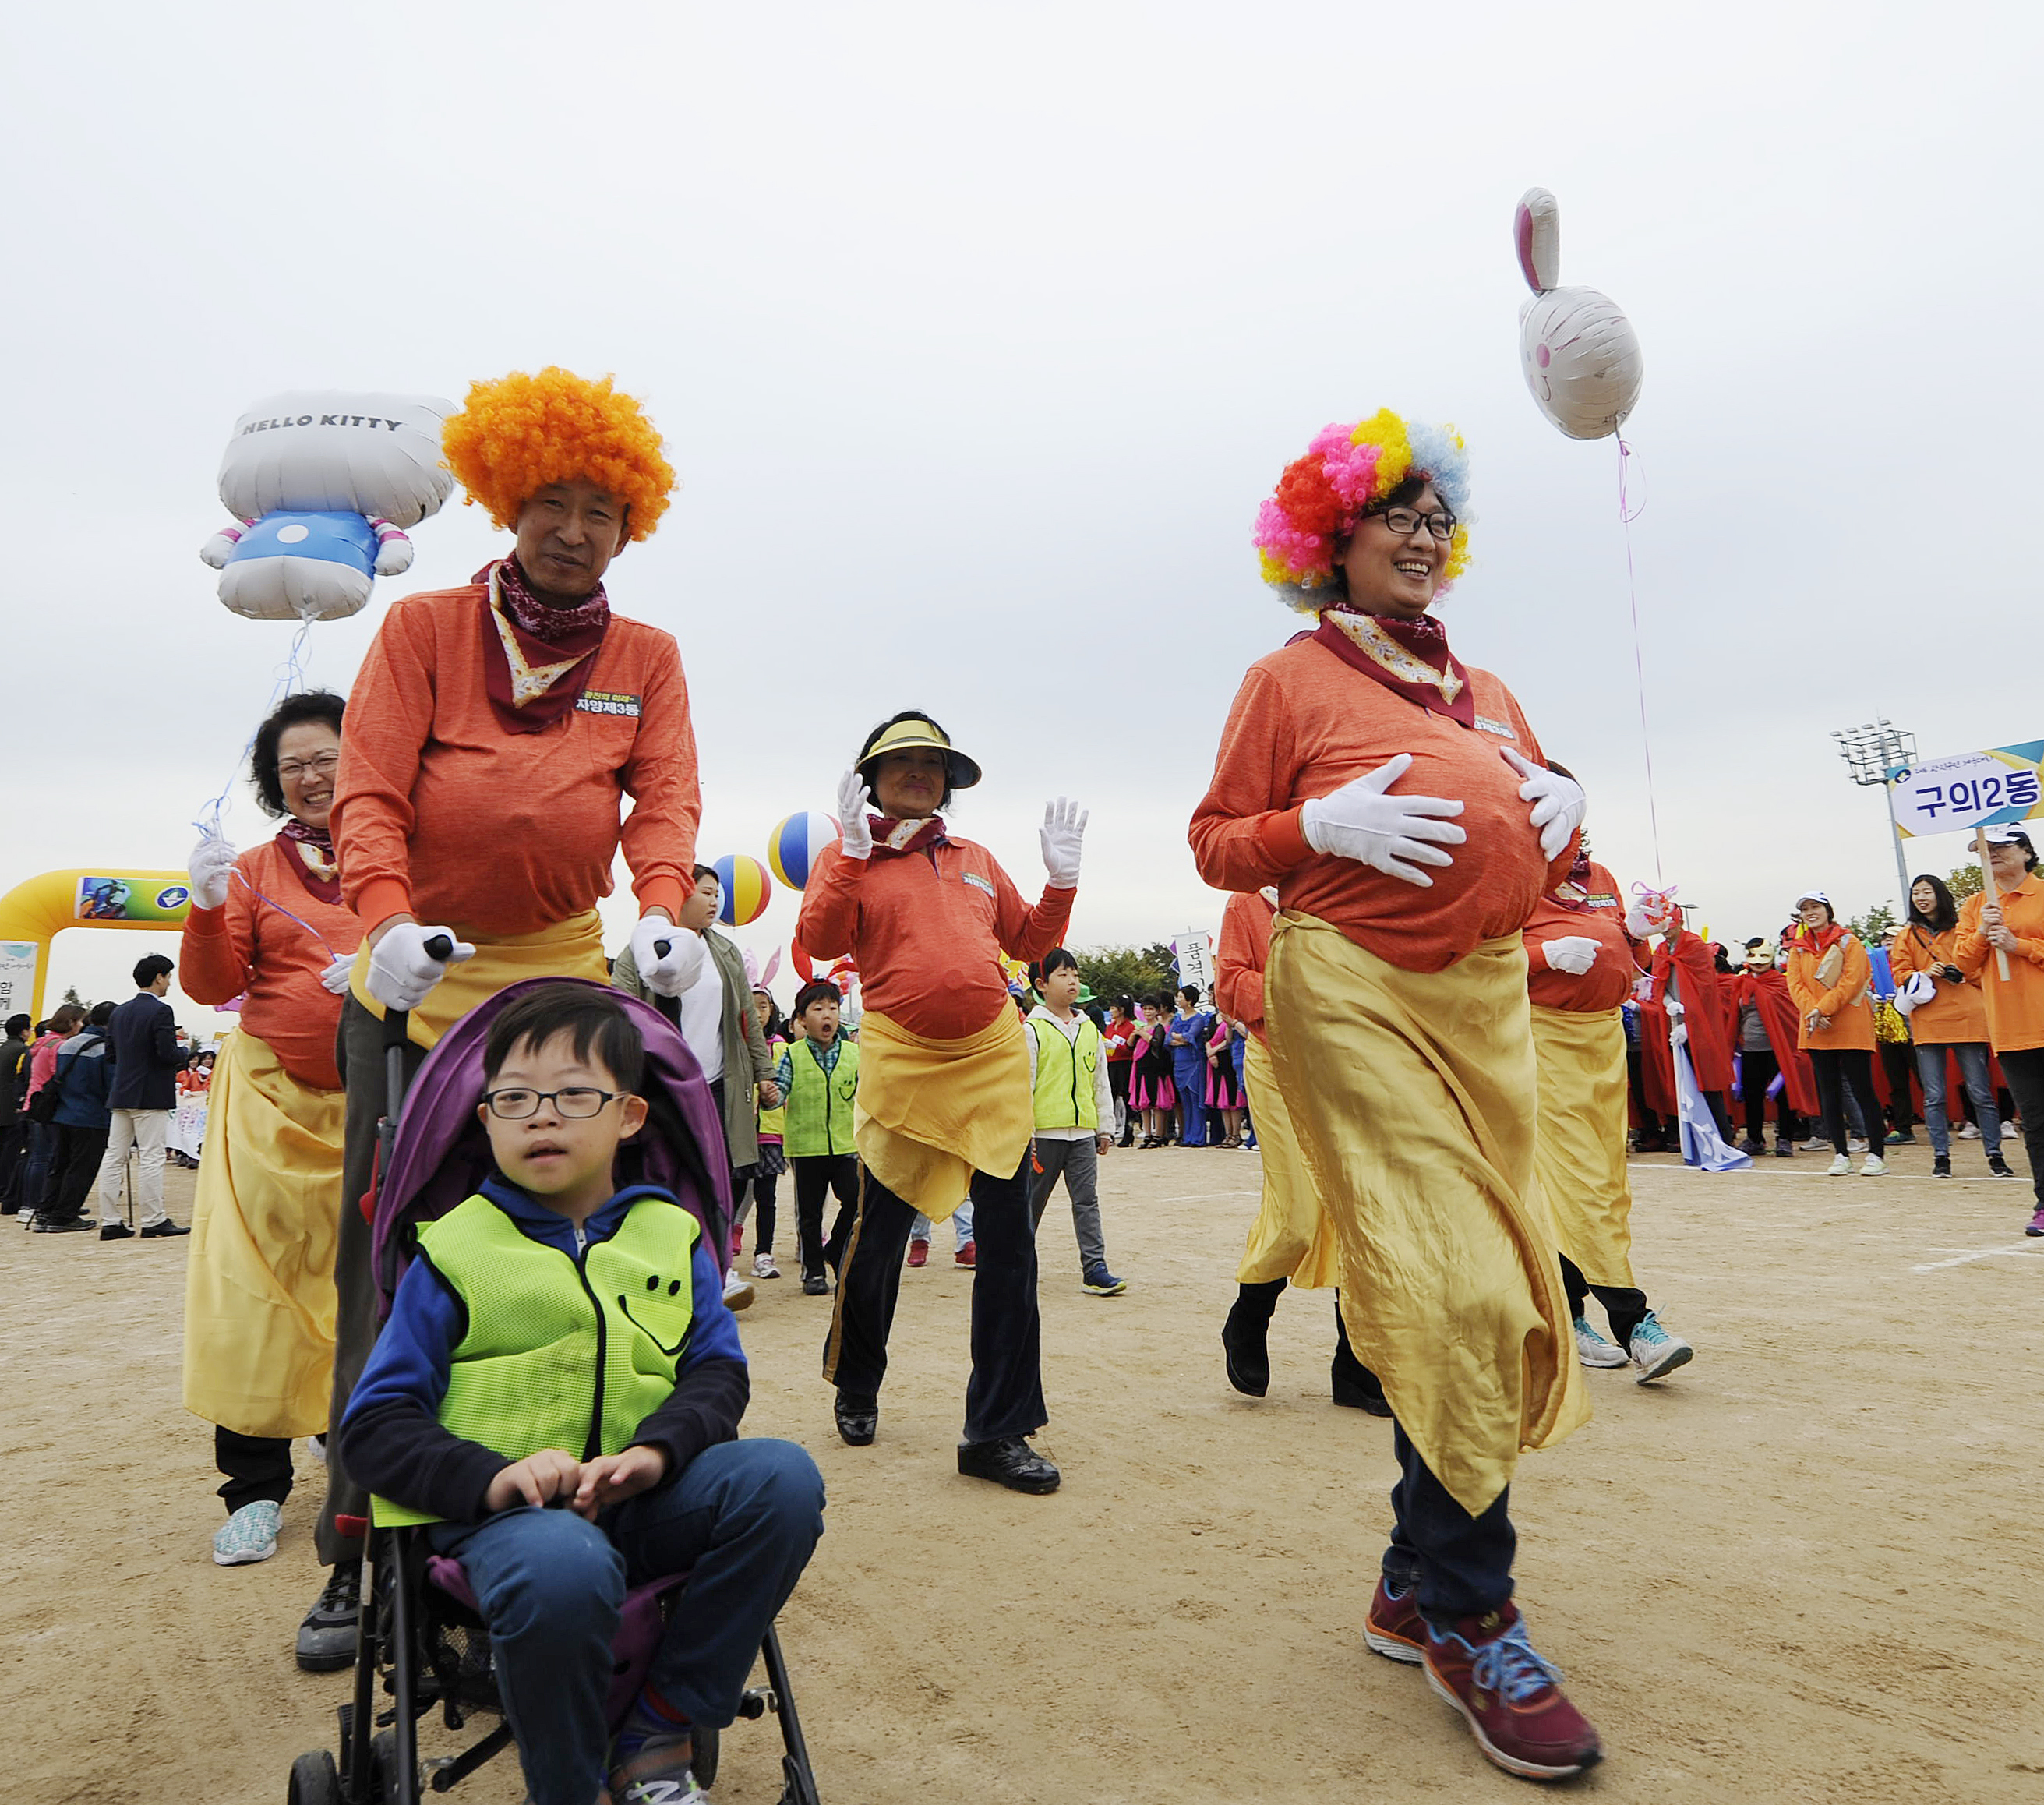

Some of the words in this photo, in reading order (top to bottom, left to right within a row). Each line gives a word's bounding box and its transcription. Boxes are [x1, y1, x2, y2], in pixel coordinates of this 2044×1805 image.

[242, 415, 313, 436] HELLO
[320, 415, 404, 432] KITTY
[576, 698, 640, 716] 자양제3동
[1915, 770, 2039, 818] 구의2동
